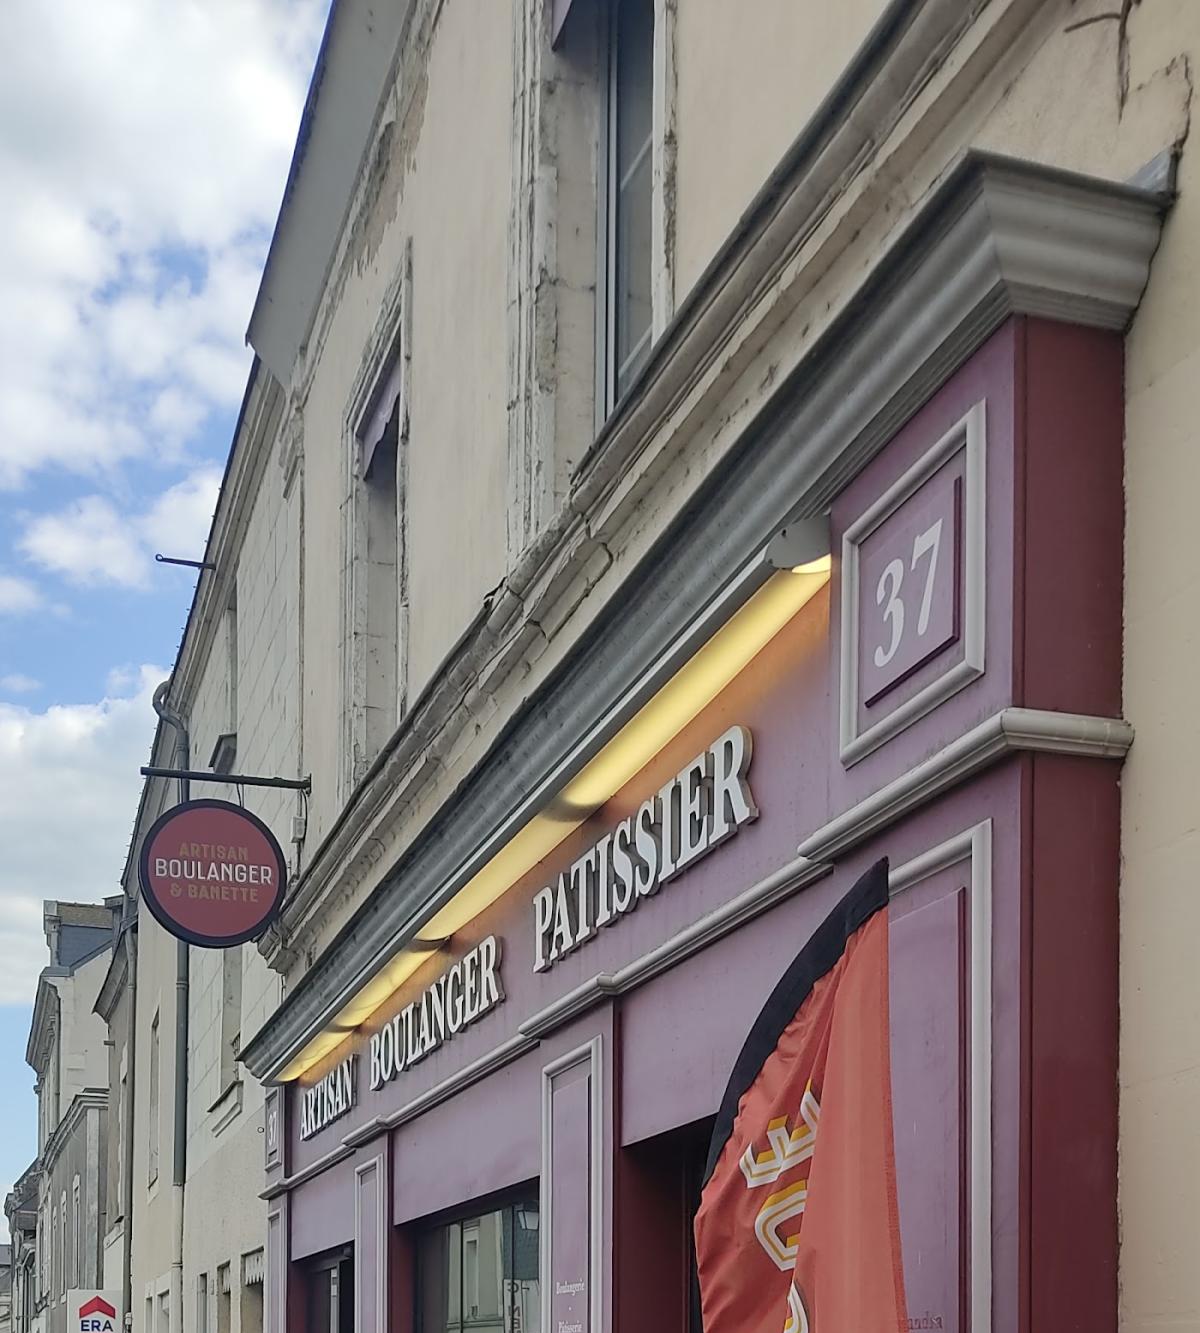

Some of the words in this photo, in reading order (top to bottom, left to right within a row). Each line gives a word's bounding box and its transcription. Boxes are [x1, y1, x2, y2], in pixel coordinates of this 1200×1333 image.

[874, 518, 943, 667] 37
[179, 842, 249, 861] ARTISAN
[155, 858, 272, 885] BOULANGER
[170, 882, 182, 898] &
[188, 883, 259, 903] BANETTE
[299, 1053, 358, 1141] ARTISAN
[369, 935, 506, 1092] BOULANGER
[532, 725, 759, 973] PATISSIER
[556, 1278, 584, 1296] Boulangerie
[81, 1320, 113, 1332] ERA
